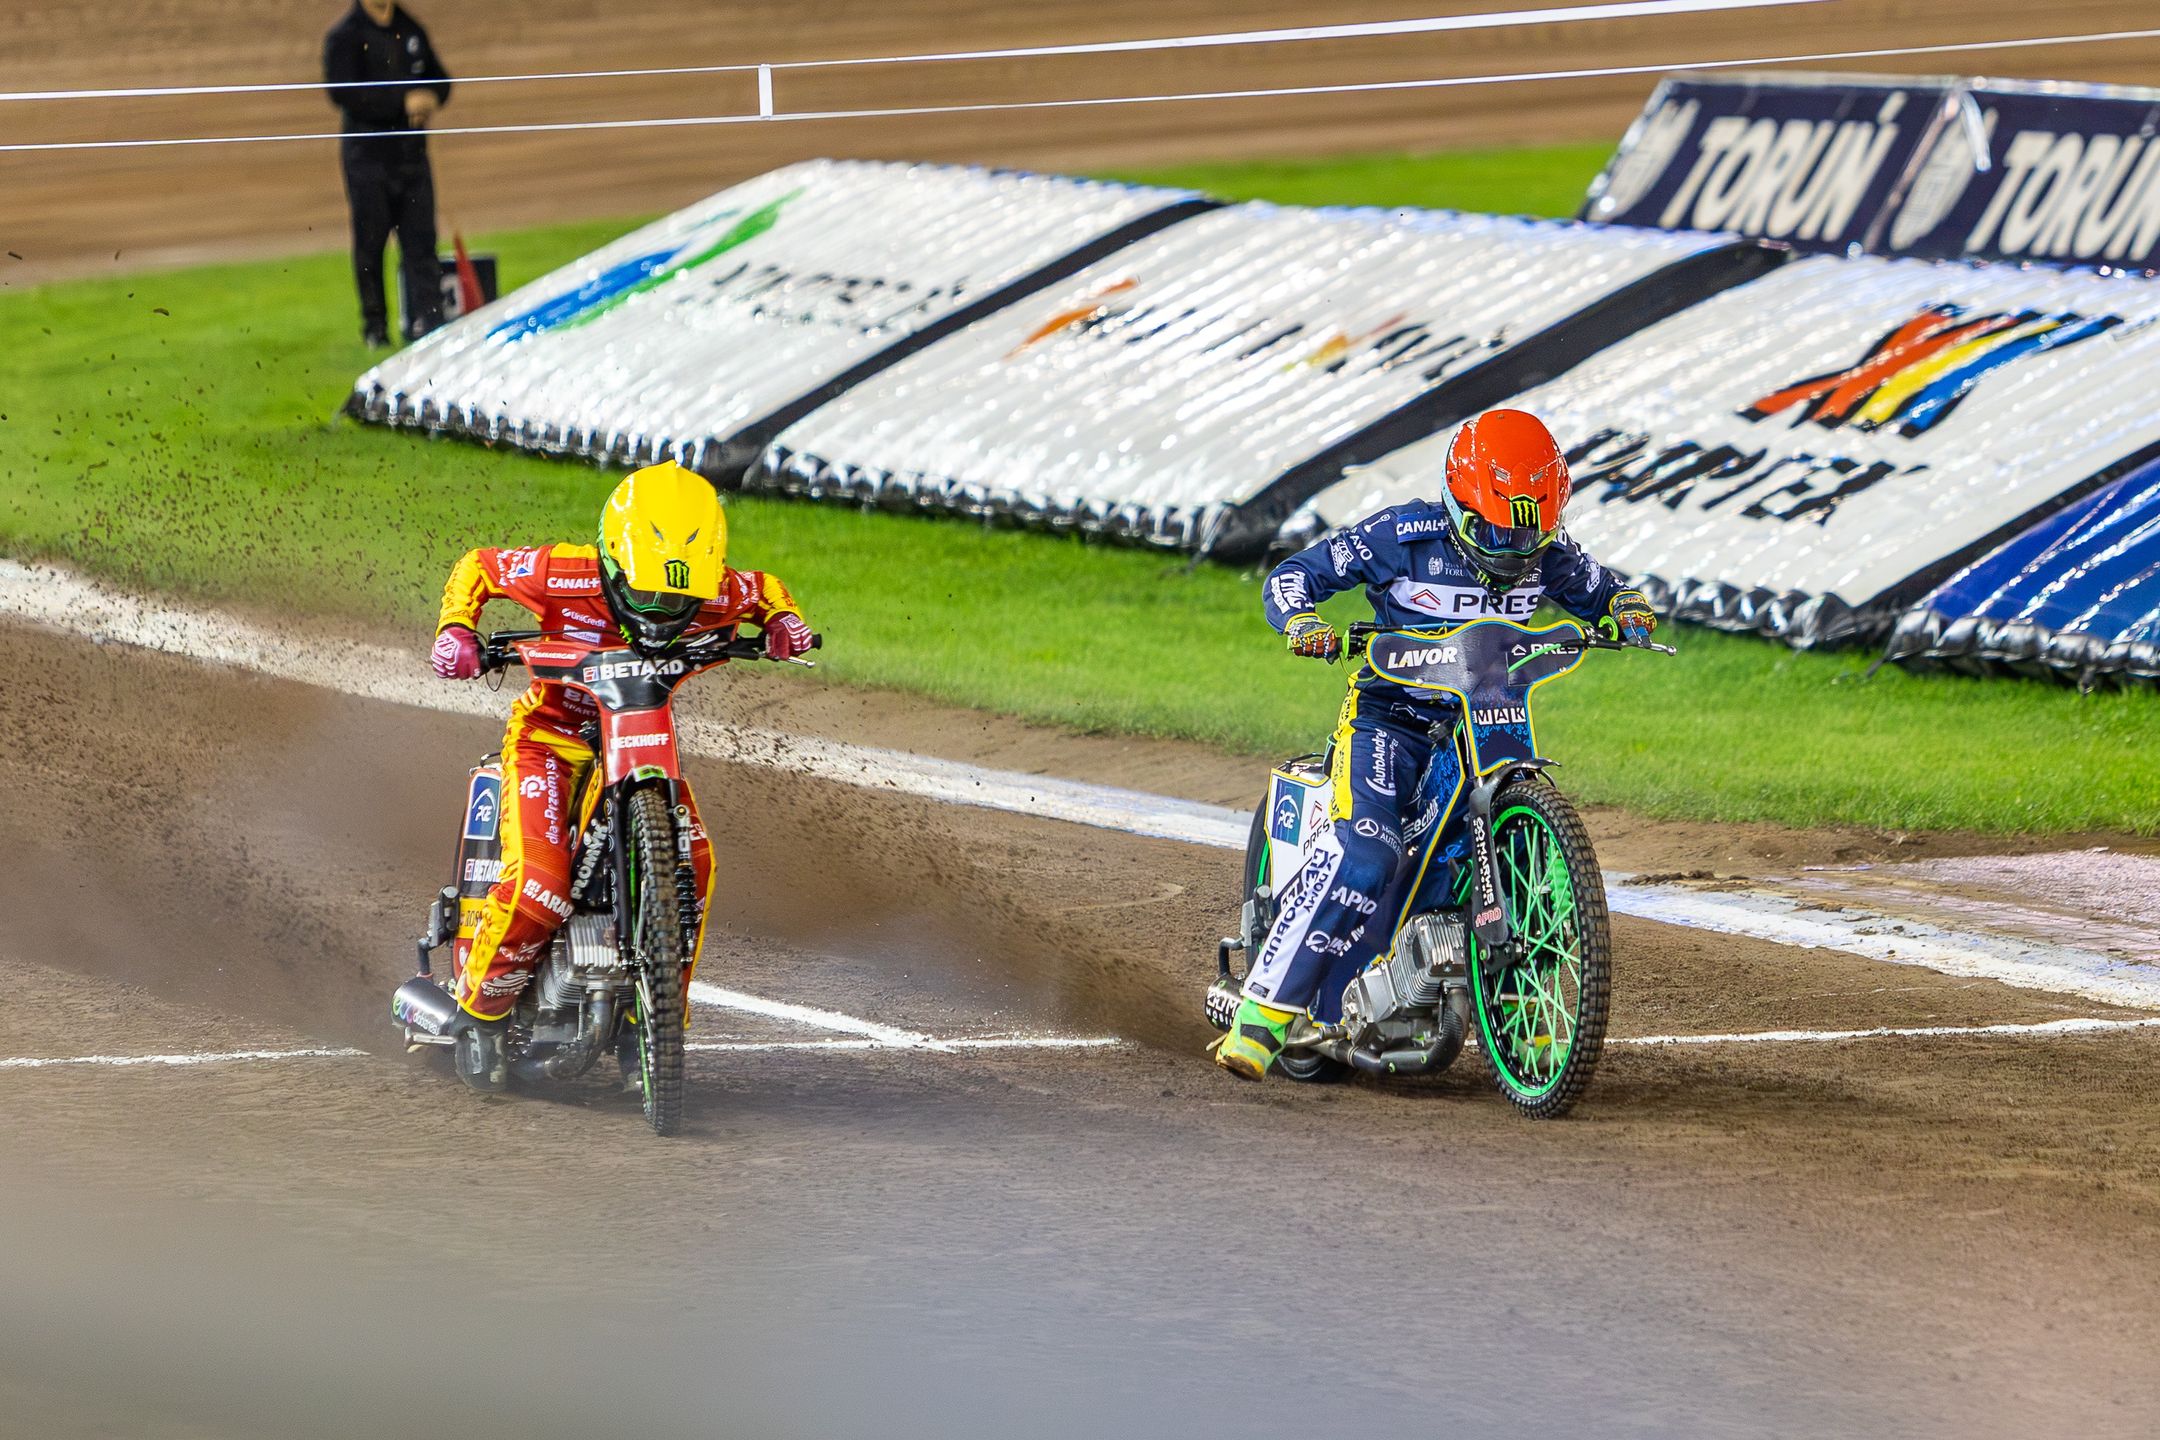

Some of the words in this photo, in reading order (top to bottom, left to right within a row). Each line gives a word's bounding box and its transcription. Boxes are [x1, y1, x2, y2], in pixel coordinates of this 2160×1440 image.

[1660, 91, 1908, 242] TORUŃ
[1396, 518, 1448, 535] CANAL+
[547, 577, 600, 589] CANAL+
[1452, 593, 1539, 615] PRES
[571, 611, 606, 628] UniCredit
[1387, 647, 1458, 669] LAVOR
[600, 659, 684, 681] BETARD
[474, 805, 493, 822] PGE
[1277, 810, 1296, 830] PGE
[1303, 872, 1329, 914] DOMY
